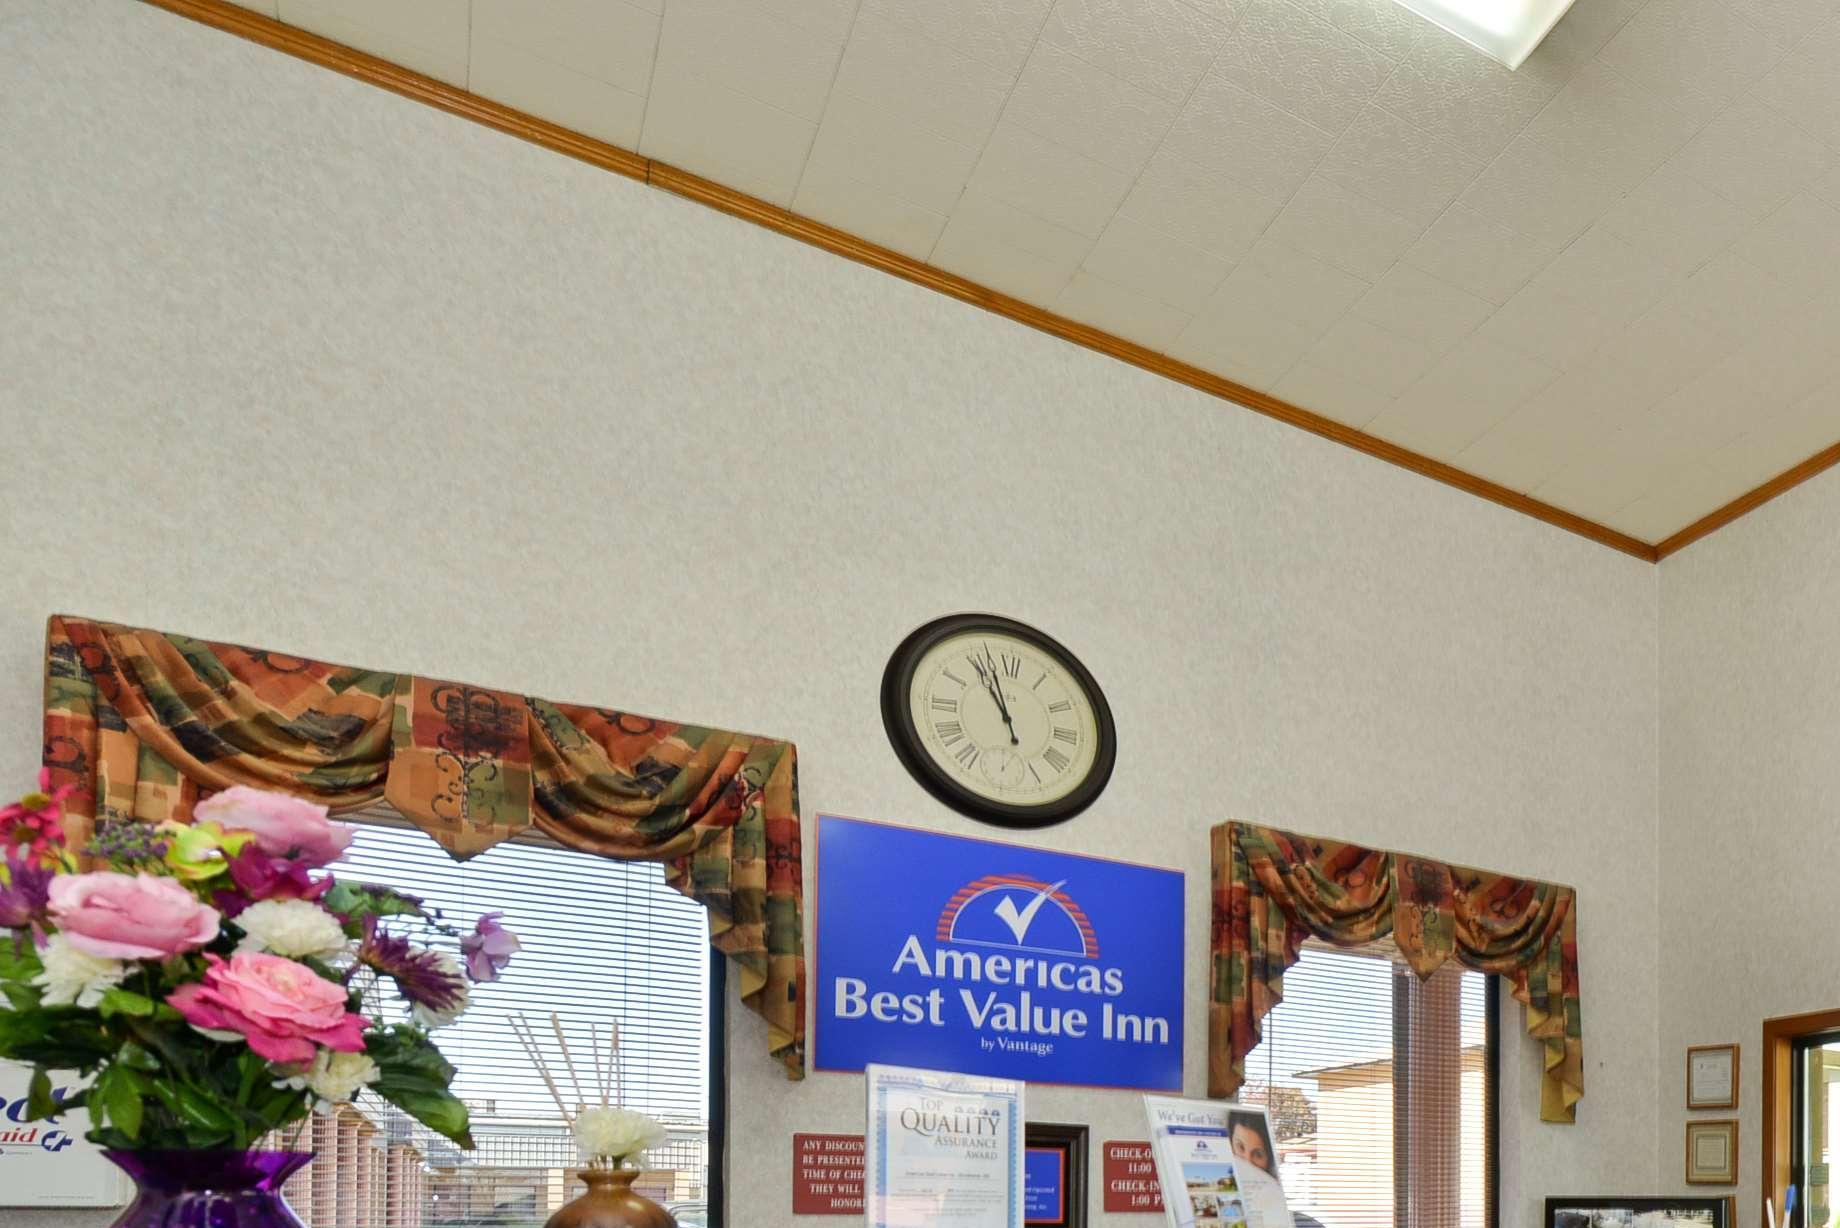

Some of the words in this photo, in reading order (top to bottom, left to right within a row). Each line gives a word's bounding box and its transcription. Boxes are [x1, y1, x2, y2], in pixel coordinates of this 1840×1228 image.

[892, 934, 1124, 996] Americas
[834, 976, 945, 1026] Best
[959, 987, 1088, 1038] Value
[1102, 1002, 1169, 1045] Inn
[981, 1036, 995, 1053] by
[997, 1036, 1054, 1055] Vantage
[920, 1097, 945, 1111] TOP
[900, 1107, 1000, 1136] QUALITY
[803, 1140, 822, 1151] ANY
[934, 1135, 998, 1149] ASSURANCE
[803, 1155, 814, 1164] BE
[965, 1151, 998, 1161] AWARD
[1128, 1162, 1152, 1174] 11:00
[803, 1169, 826, 1179] TIME
[830, 1170, 841, 1180] OF
[810, 1184, 833, 1194] THEY
[838, 1184, 860, 1193] WILL
[1131, 1194, 1150, 1206] 1:00
